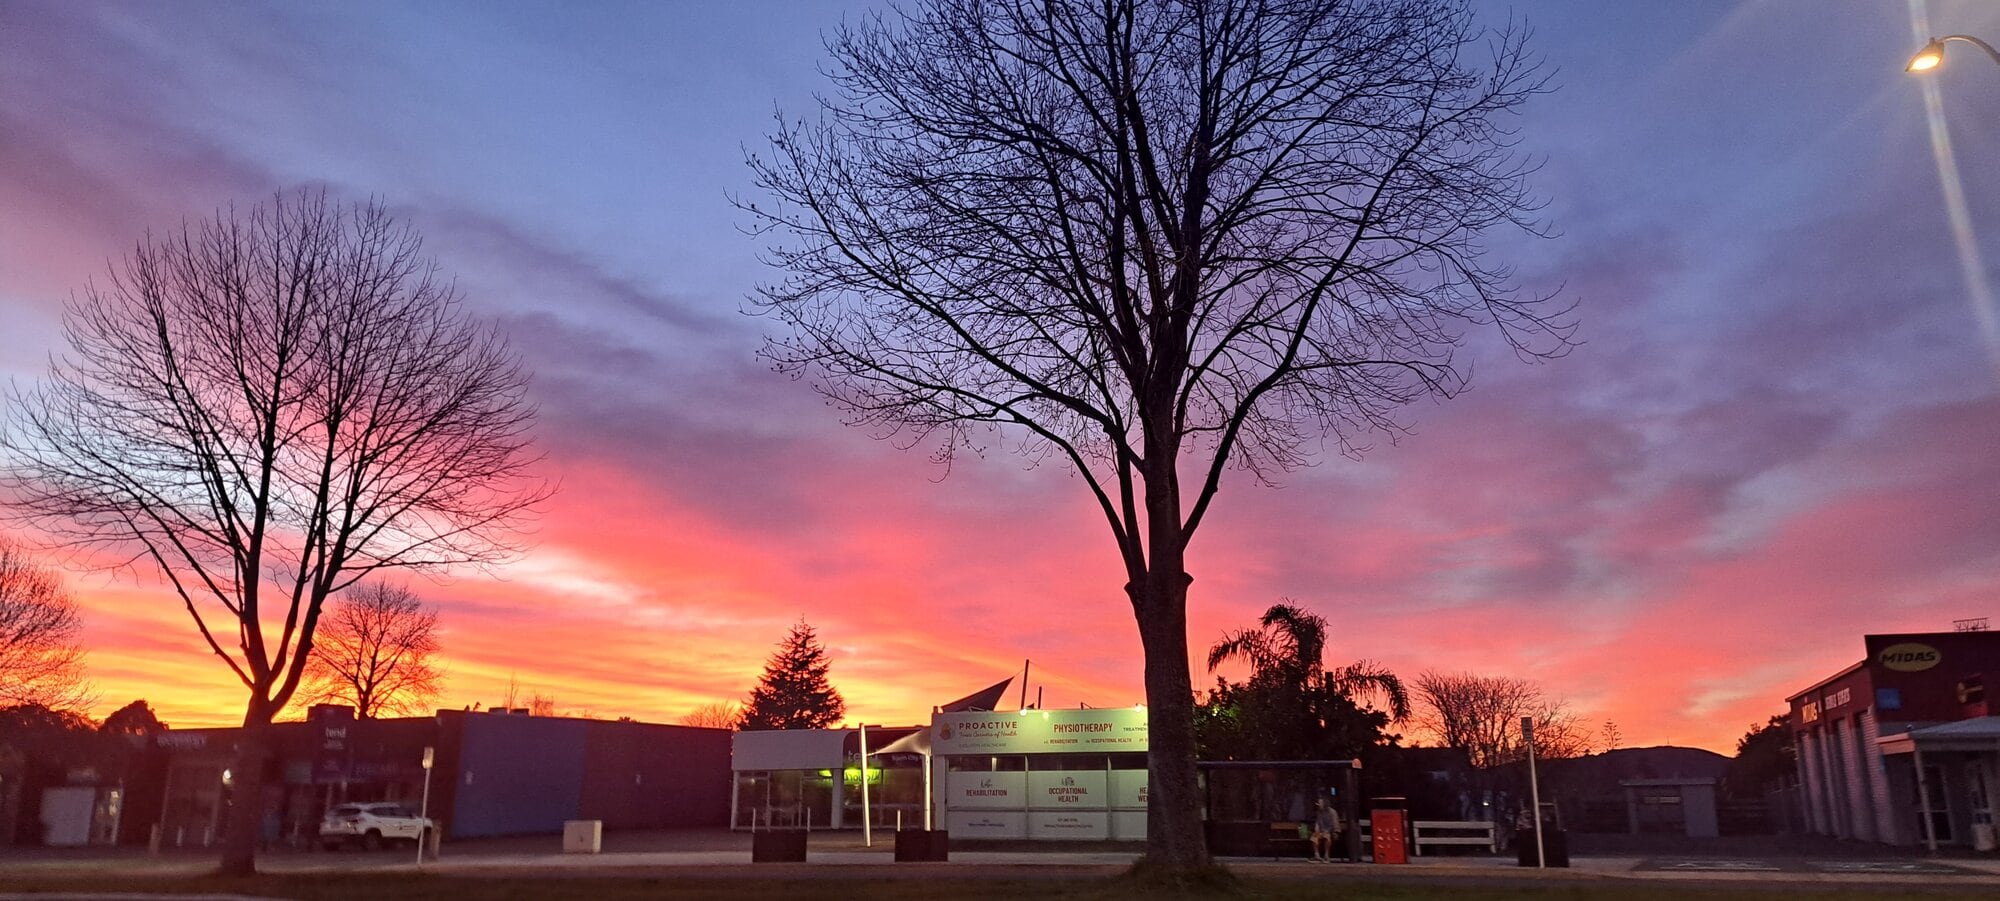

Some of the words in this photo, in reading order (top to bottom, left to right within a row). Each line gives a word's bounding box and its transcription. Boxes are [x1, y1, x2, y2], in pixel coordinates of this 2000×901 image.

[1882, 651, 1935, 663] MIDAS
[959, 721, 1018, 730] PROACTIVE
[1053, 722, 1113, 733] PHYSIOTHERAPY
[966, 789, 1008, 797] REHABILITATION
[1048, 787, 1088, 795] OCCUPATIONAL
[1058, 795, 1079, 803] HEALTH
